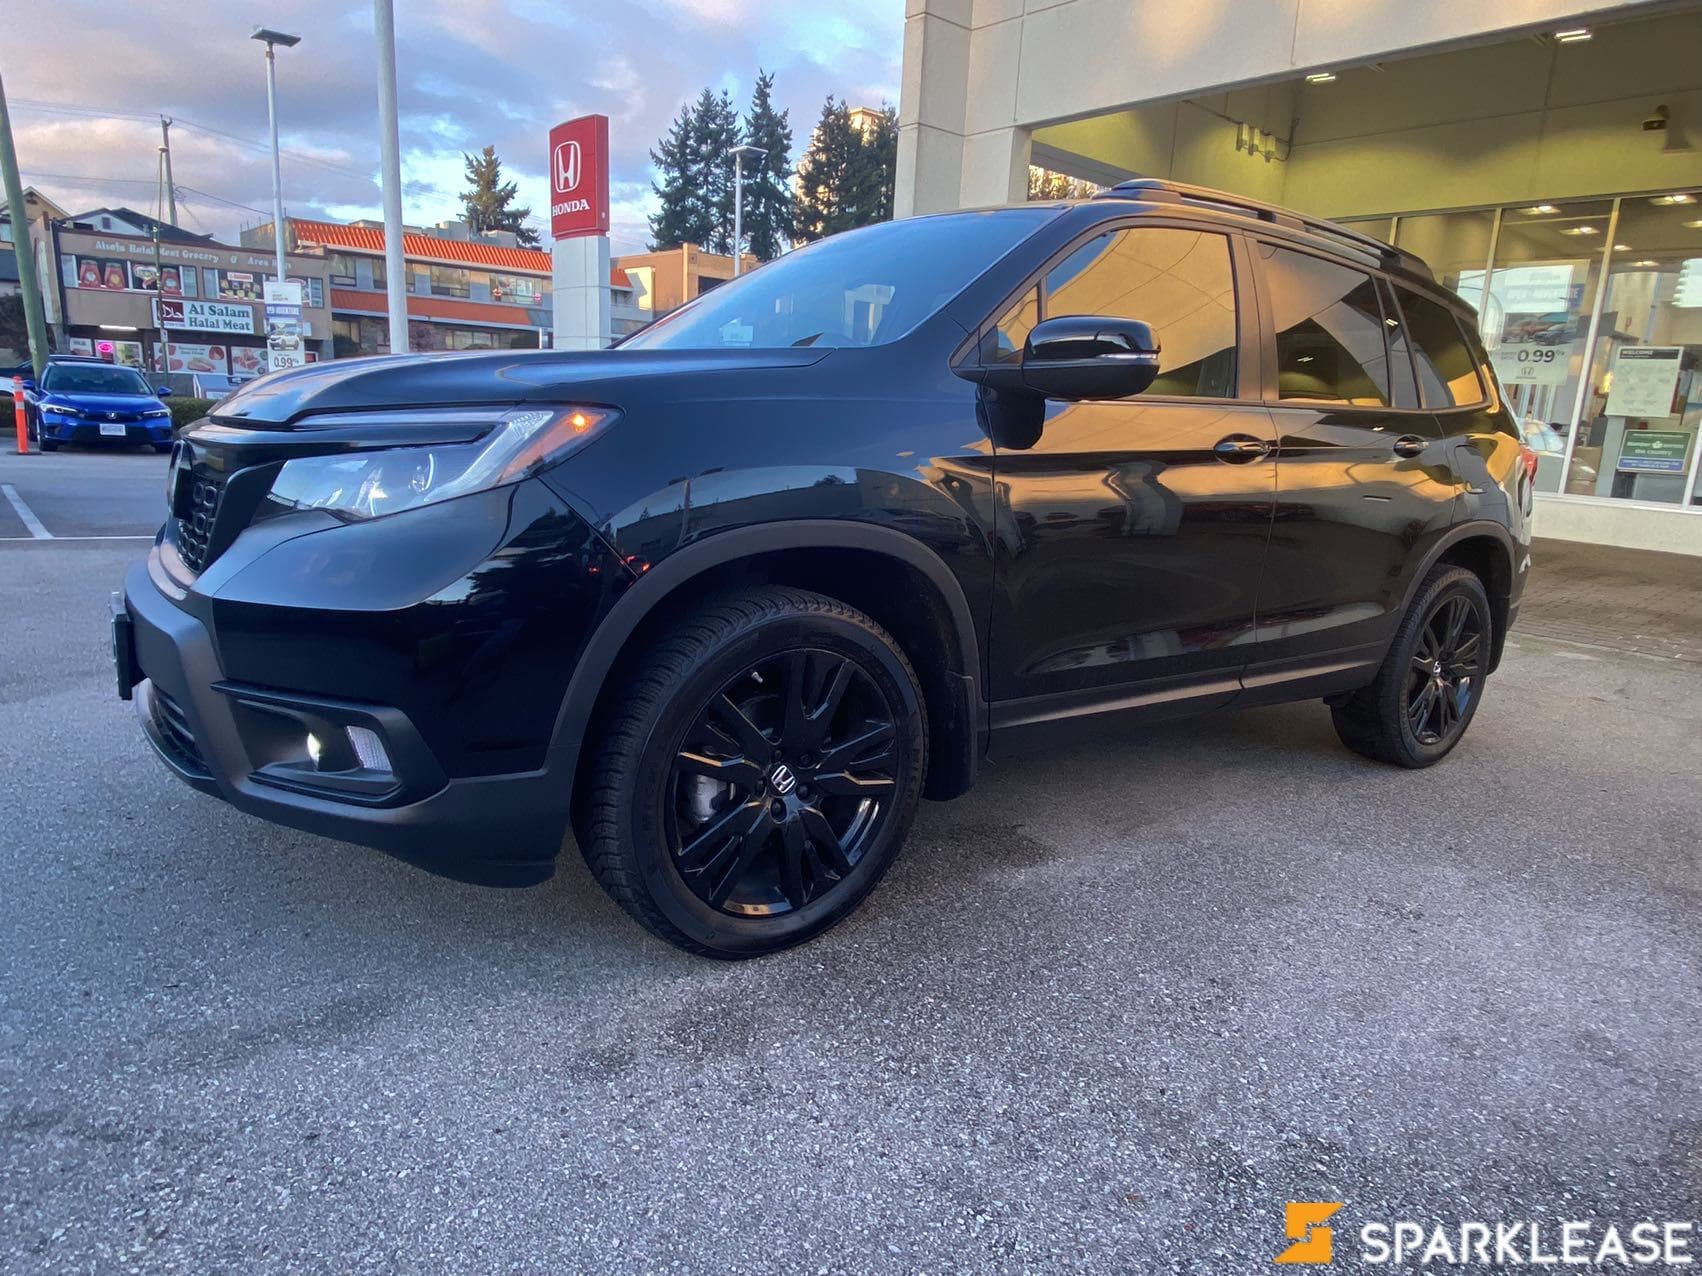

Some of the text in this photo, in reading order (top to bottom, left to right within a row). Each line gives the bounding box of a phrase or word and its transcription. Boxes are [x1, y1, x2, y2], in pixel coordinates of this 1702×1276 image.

[552, 198, 591, 217] HONDA
[182, 250, 219, 263] Grocery
[188, 303, 250, 318] Al Salam
[188, 317, 219, 329] Halal
[221, 319, 251, 331] Meat
[273, 356, 293, 368] 0.99
[1517, 349, 1555, 363] 0.99
